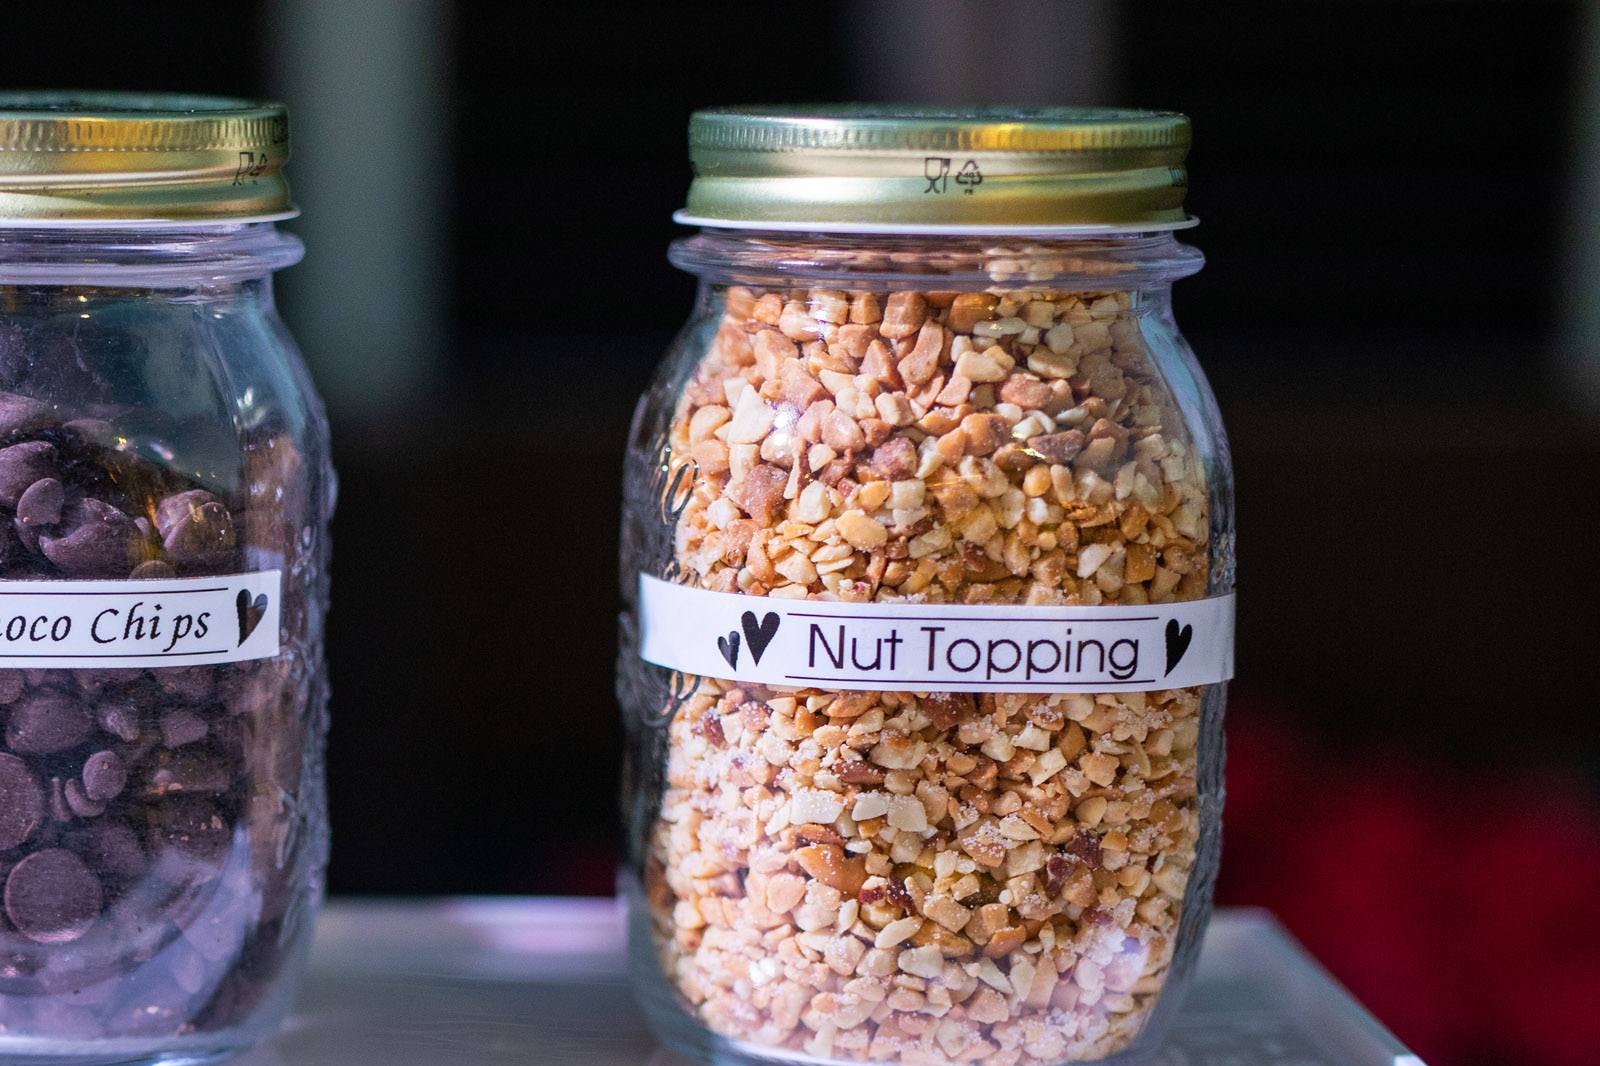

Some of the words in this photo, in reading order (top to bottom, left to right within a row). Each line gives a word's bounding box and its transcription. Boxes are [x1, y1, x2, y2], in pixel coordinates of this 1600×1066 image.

[90, 602, 211, 652] Chips
[808, 622, 904, 672] Nut
[920, 626, 1140, 681] Topping
